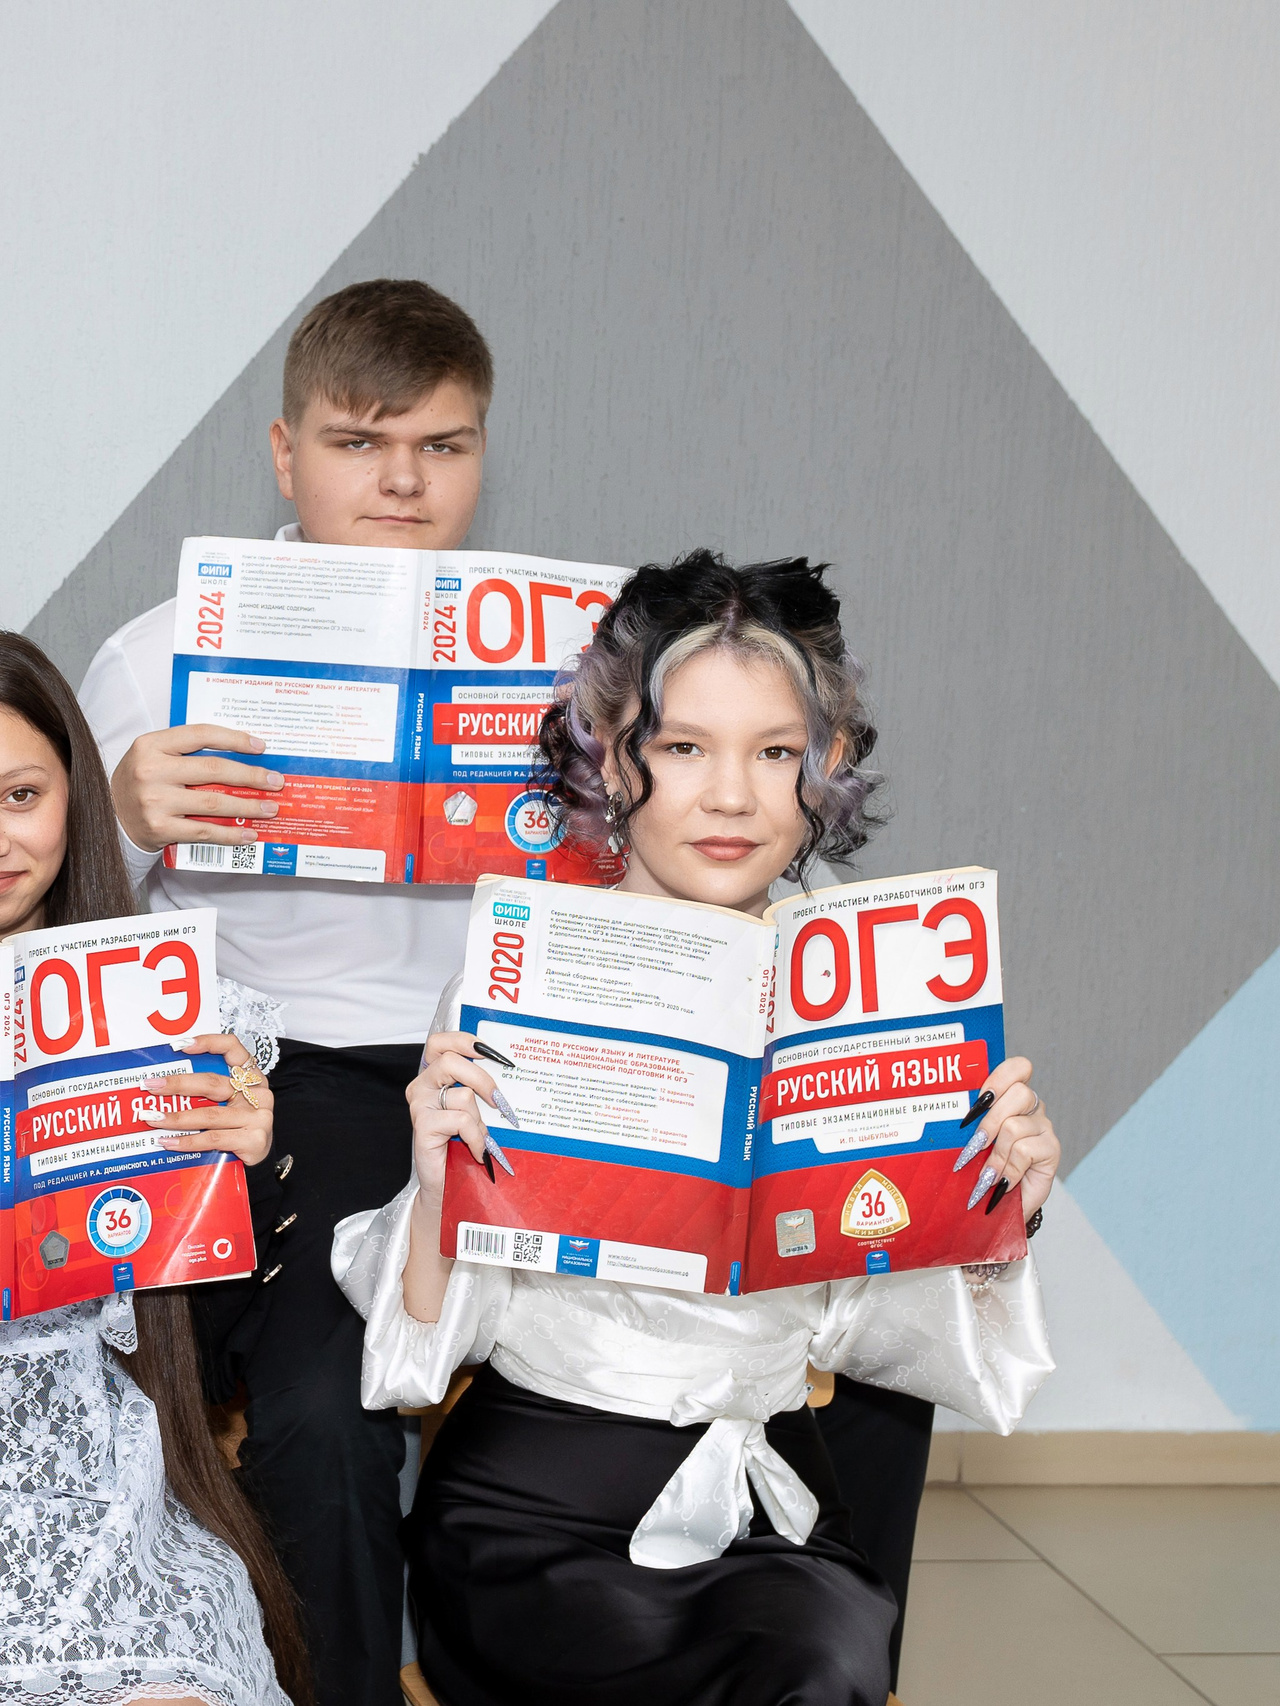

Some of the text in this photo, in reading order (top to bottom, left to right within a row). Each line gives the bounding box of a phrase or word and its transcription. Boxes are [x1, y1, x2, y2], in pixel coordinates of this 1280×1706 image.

[200, 565, 230, 576] ФИПИ
[507, 568, 538, 576] УЧАСТИЕМ
[541, 572, 587, 585] РАЗРАБОТЧИКОВ
[197, 591, 225, 649] 2024
[433, 605, 456, 663] 2024
[414, 693, 424, 760] РУССКИЙ ЯЗЫК
[524, 811, 549, 828] 36
[495, 906, 529, 918] ФИПИ
[793, 881, 985, 920] ПРОЕКТ С УЧАСТИЕМ РАЗРАБОТЧИКОВ КИМ ОГЭ
[495, 920, 526, 928] ШКОЛЕ
[29, 947, 50, 959] ПРОЕКТ
[61, 939, 98, 951] УЧАСТИЕМ
[101, 930, 160, 946] РАЗРАБОТЧИКОВ
[163, 928, 179, 936] КИМ
[183, 926, 196, 934] ОГЭ
[488, 932, 524, 1004] 2020
[791, 897, 988, 1021] ОГЭ
[761, 969, 769, 988] ОГЭ
[30, 940, 201, 1055] ОГЭ
[510, 1044, 564, 1057] ИЗДАТЕЛЬСТВА
[524, 1037, 548, 1045] КНИГИ
[563, 1042, 598, 1053] РУССКОМУ
[601, 1047, 625, 1056] ЯЗЫКУ
[636, 1052, 680, 1065] ЛИТЕРАТУРЕ
[777, 1031, 956, 1064] ОСНОВНОЙ ГОСУДАРСТВЕННЫЙ ЭКЗАМЕН
[529, 1054, 561, 1063] СИСТЕМА
[564, 1059, 616, 1071] КОМПЛЕКСНОЙ
[619, 1066, 665, 1080] ПОДГОТОВКИ
[777, 1054, 962, 1106] РУССКИЙ ЯЗЫК
[32, 1067, 187, 1101] ОСНОВНОЙ ГОСУДАРСТВЕННЫЙ ЭКЗАМЕН
[32, 1096, 122, 1142] РУССКИЙ
[743, 1086, 758, 1161] РУССКИЙ ЯЗЫК
[781, 1100, 959, 1132] ТИПОВЫЕ ЭКЗАМЕНАЦИОННЫЕ ВАРИАНТЫ
[3, 1107, 11, 1183] РУССКИЙ ЯЗЫК
[859, 1130, 898, 1143] ЦЫБУЛЬКО
[38, 1139, 146, 1167] ТИПОВЫЕ ЭКЗАМЕНАЦИОННЫЕ
[34, 1181, 46, 1189] ПОД
[48, 1171, 88, 1187] РЕДАКЦИЕЙ
[104, 1161, 149, 1175] ДОЩИНСКОГО,
[167, 1152, 201, 1164] ЦЫБУЛЬКО
[845, 1180, 903, 1216] НОВАЯ МОДЕЛЬ
[861, 1190, 885, 1219] 36
[105, 1209, 131, 1231] 36
[856, 1216, 894, 1227] ВАРИАНТОВ
[877, 1226, 895, 1235] ОГЭ
[857, 1238, 895, 1247] СООТВЕТСТВУЕТ
